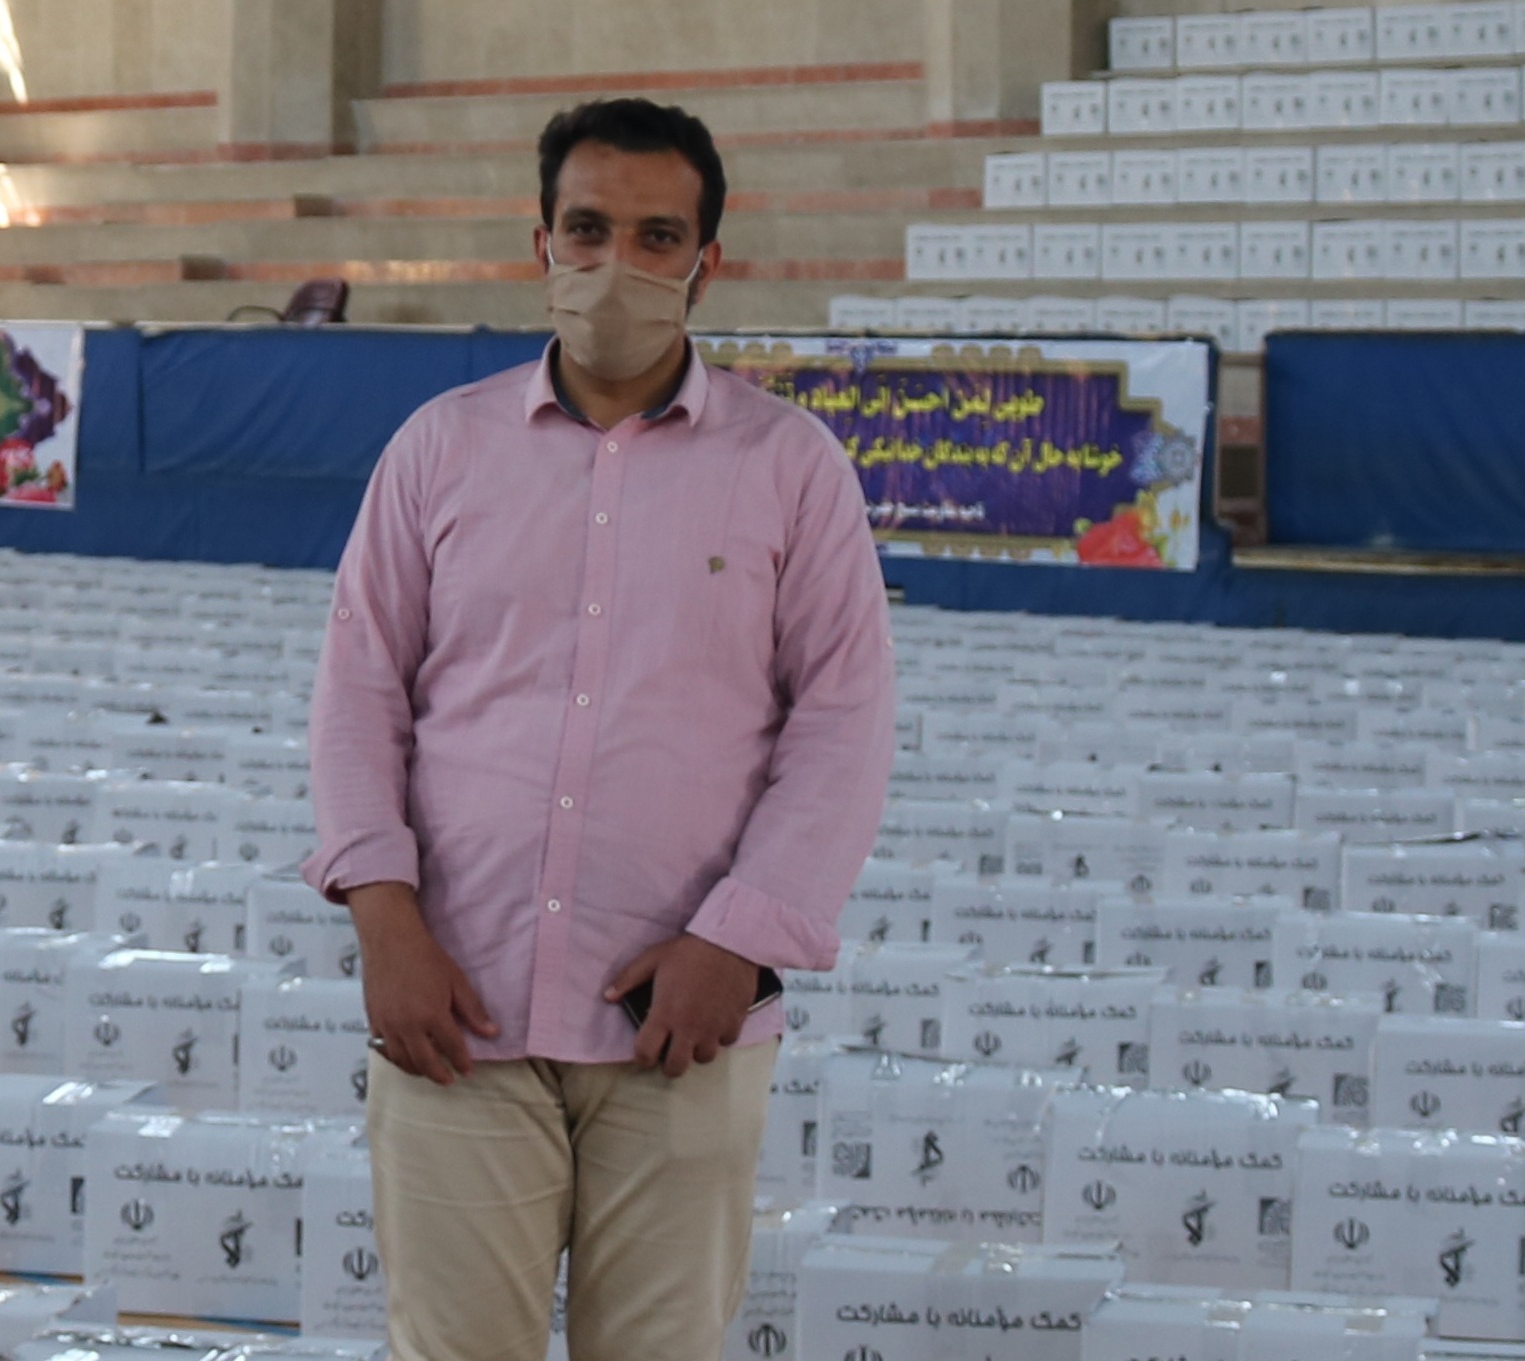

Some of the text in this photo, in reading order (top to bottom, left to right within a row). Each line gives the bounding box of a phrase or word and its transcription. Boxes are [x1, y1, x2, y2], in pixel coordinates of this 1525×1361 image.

[218, 997, 240, 1012] مک
[782, 1079, 819, 1096] مک
[51, 1131, 84, 1149] مک
[1078, 1143, 1147, 1167] مشارکت
[1152, 1147, 1165, 1168] با
[187, 1167, 200, 1188] با
[272, 1173, 303, 1190] مک
[1328, 1181, 1402, 1203] مشارکت
[1407, 1184, 1421, 1206] با
[1499, 1188, 1525, 1207] مک
[837, 1303, 920, 1328] مشارکت
[926, 1307, 942, 1332] با
[1032, 1312, 1083, 1332] کمک
